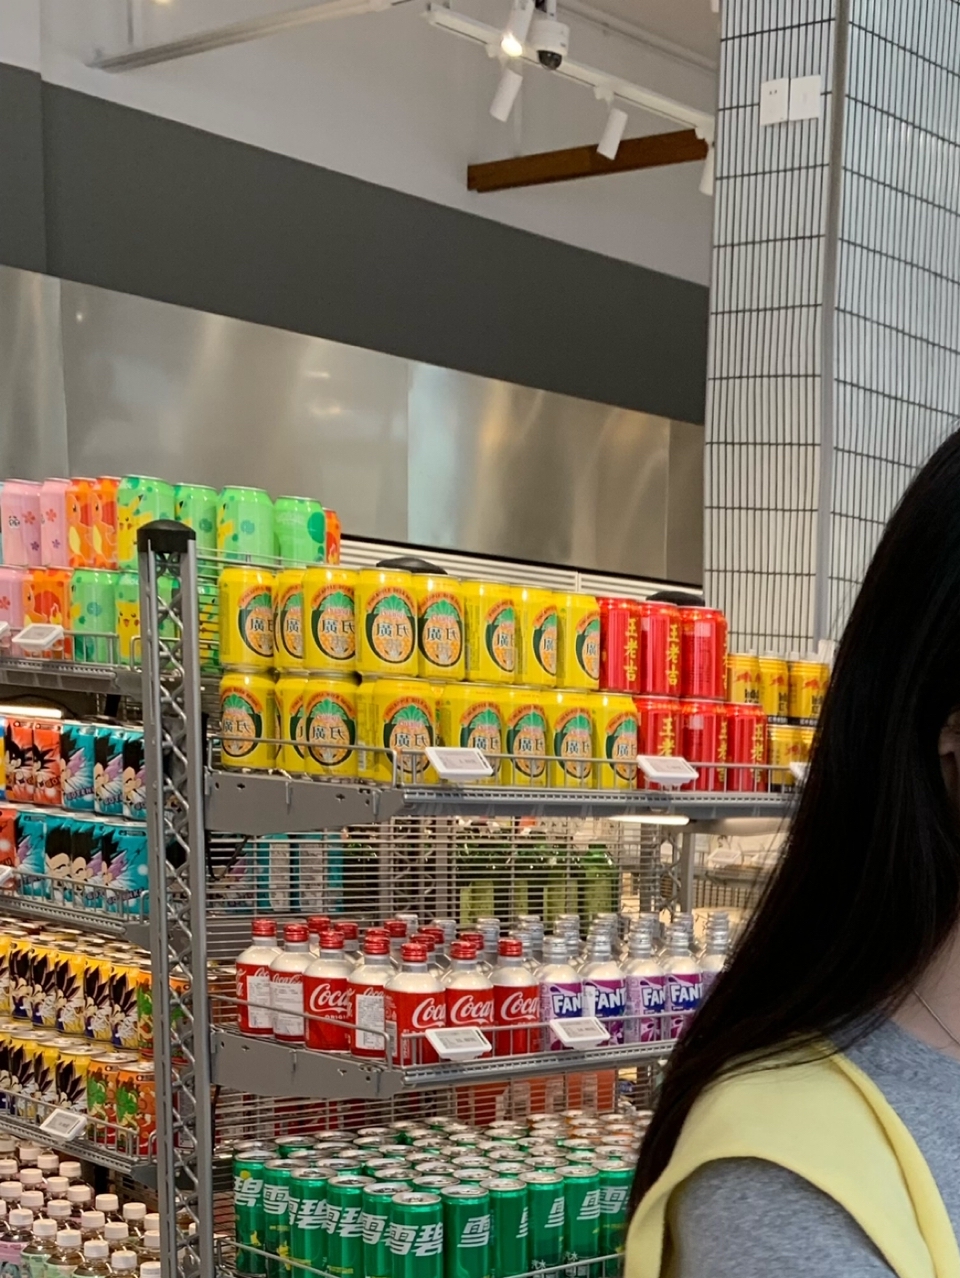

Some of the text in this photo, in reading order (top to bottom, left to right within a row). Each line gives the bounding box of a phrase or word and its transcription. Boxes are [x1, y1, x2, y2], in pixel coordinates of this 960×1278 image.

[623, 618, 639, 682] 王老吉
[666, 624, 680, 686] 王老吉
[390, 1221, 443, 1257] 雪碧
[457, 1214, 491, 1248] 雪
